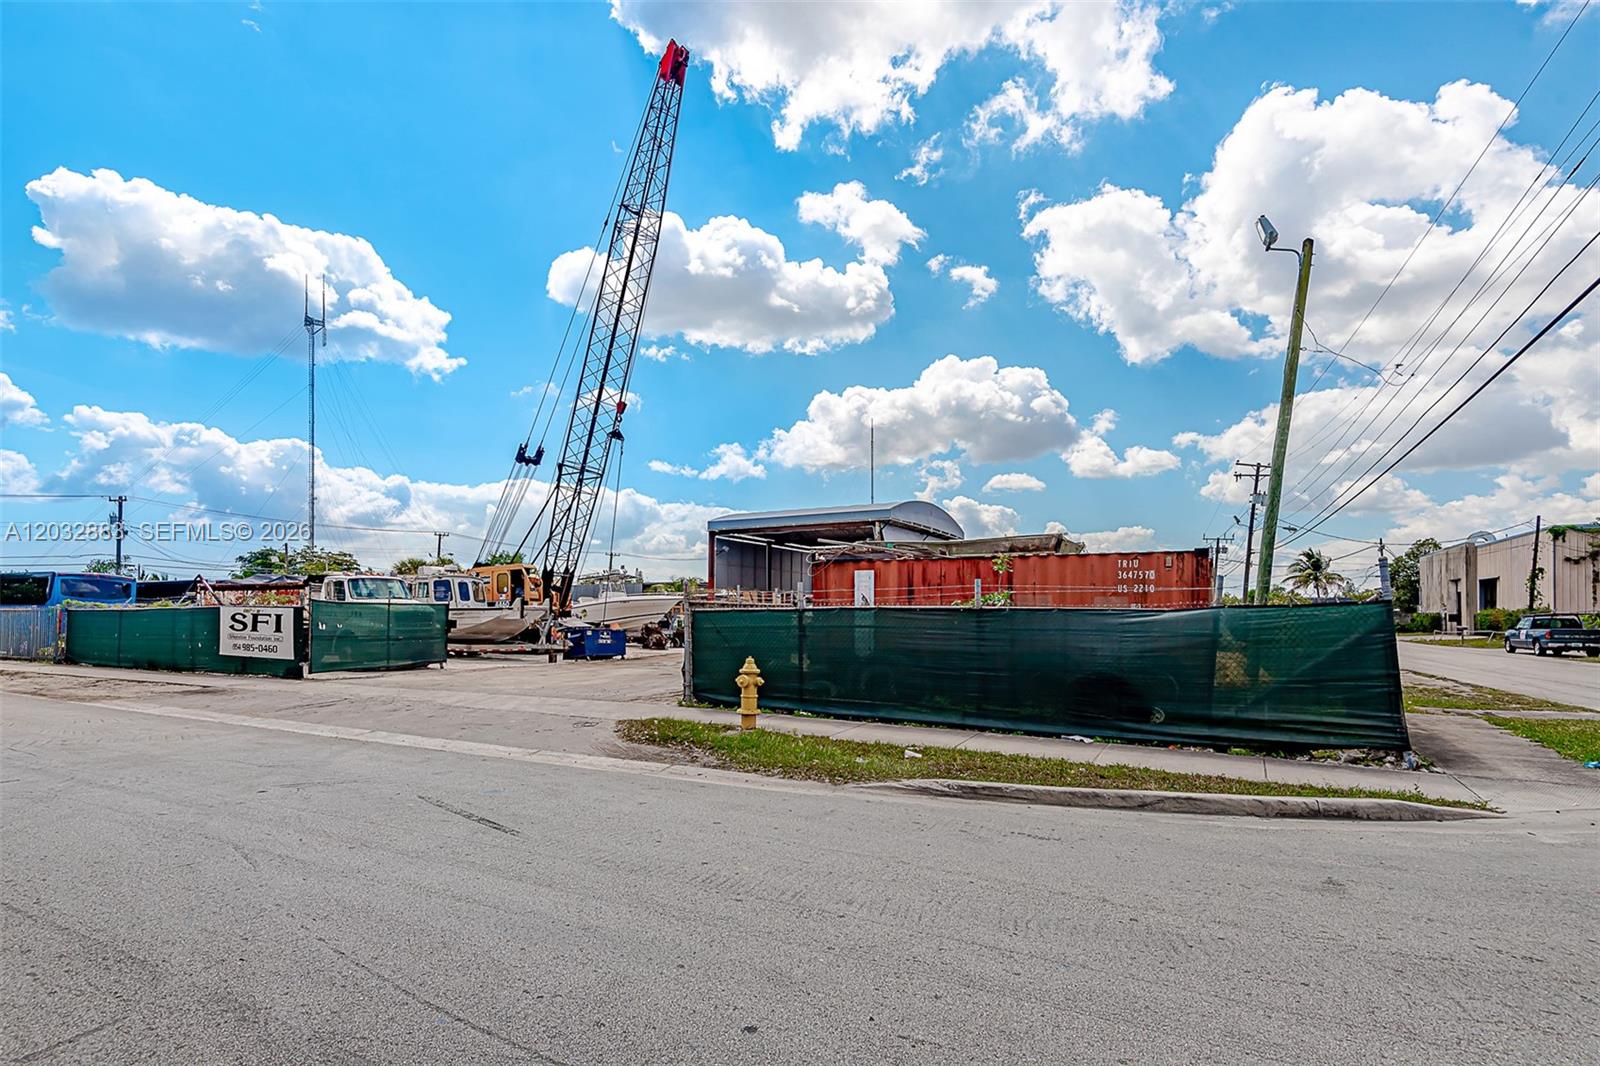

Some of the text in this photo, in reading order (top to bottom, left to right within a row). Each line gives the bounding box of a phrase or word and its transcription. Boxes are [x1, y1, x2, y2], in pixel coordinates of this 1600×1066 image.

[1117, 559, 1139, 568] TRIU
[1118, 570, 1155, 579] 3647570
[1117, 584, 1155, 593] US 2210
[228, 612, 284, 634] SFI
